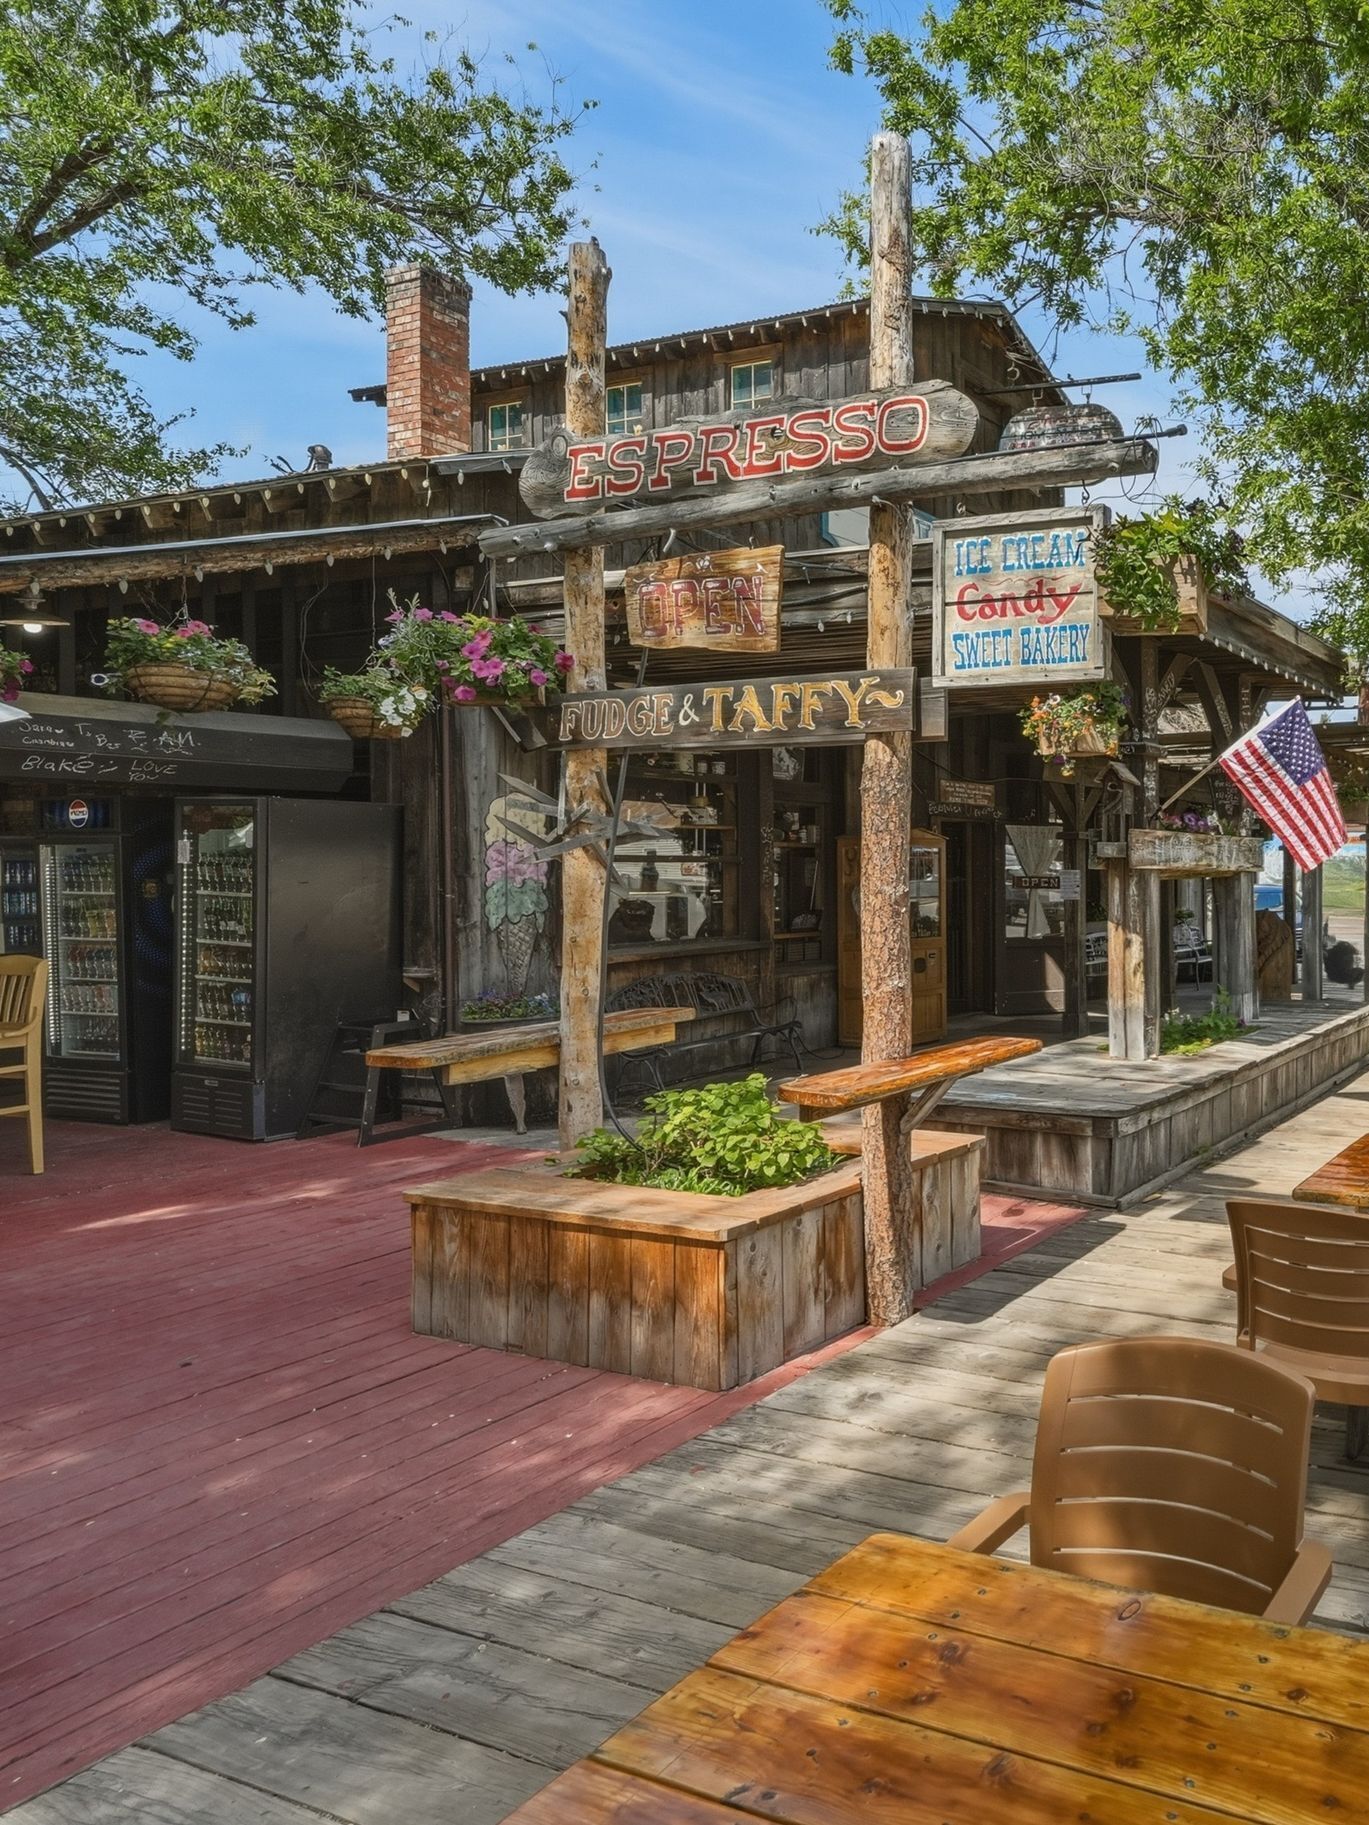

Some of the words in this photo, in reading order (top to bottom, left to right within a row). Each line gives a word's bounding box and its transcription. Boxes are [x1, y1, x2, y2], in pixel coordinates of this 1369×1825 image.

[564, 395, 928, 502] ESPRESSO
[953, 536, 994, 576] ICE
[1001, 528, 1088, 572] CREAM
[637, 576, 766, 638] OPEN
[955, 578, 1084, 625] Candy
[952, 628, 1013, 671] SWEET
[1019, 622, 1091, 666] BAKERY
[559, 693, 675, 742] FUDGE
[678, 693, 701, 727] &
[702, 675, 881, 733] TAFFY
[131, 759, 178, 775] LOVE
[1021, 877, 1059, 888] OPEN
